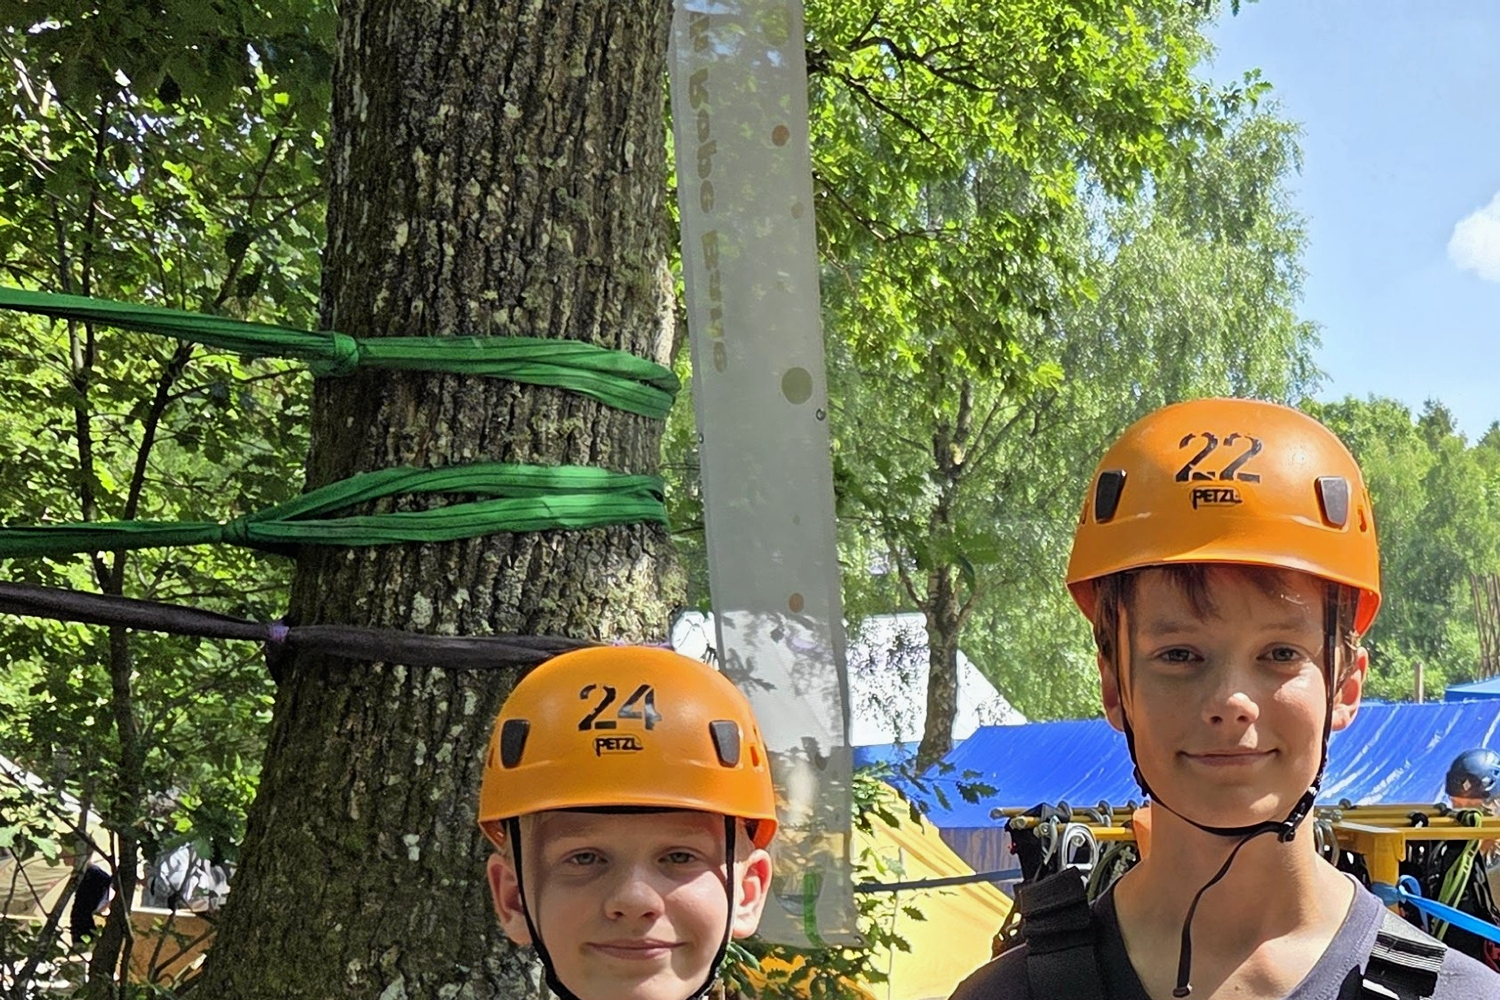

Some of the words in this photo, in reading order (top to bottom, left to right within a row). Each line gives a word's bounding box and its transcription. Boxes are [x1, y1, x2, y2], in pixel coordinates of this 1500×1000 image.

[1175, 431, 1262, 483] 22
[1192, 488, 1243, 511] PETZL
[578, 683, 663, 732] 24
[595, 736, 644, 757] PETZL
